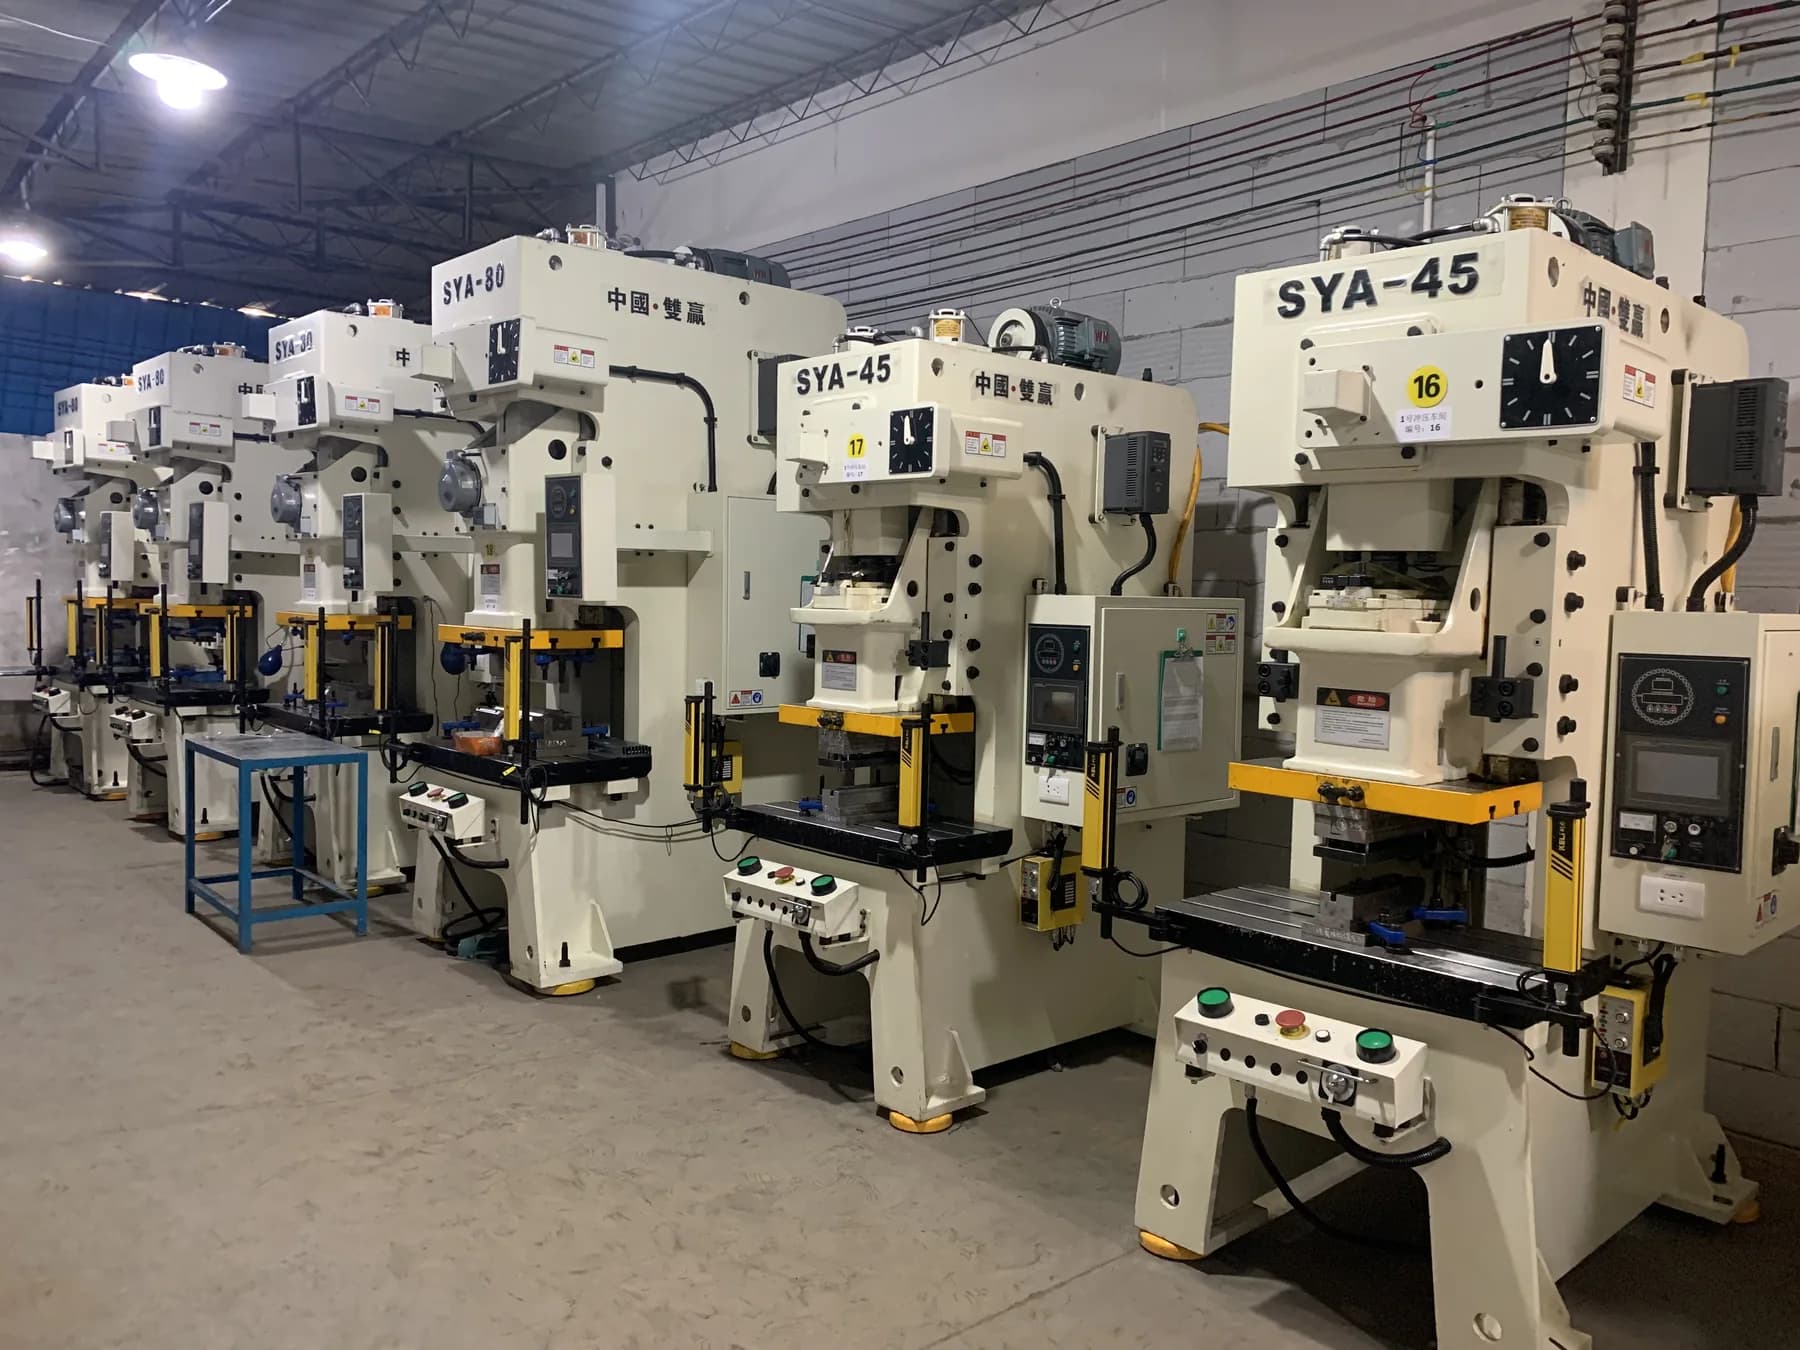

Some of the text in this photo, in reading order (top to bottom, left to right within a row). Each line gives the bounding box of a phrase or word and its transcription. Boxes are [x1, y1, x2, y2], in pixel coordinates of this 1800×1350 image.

[443, 263, 505, 306] SYA-80
[1277, 252, 1480, 320] SYA-45
[797, 353, 892, 396] SYA-45
[1413, 373, 1441, 399] 16
[849, 438, 864, 456] 17
